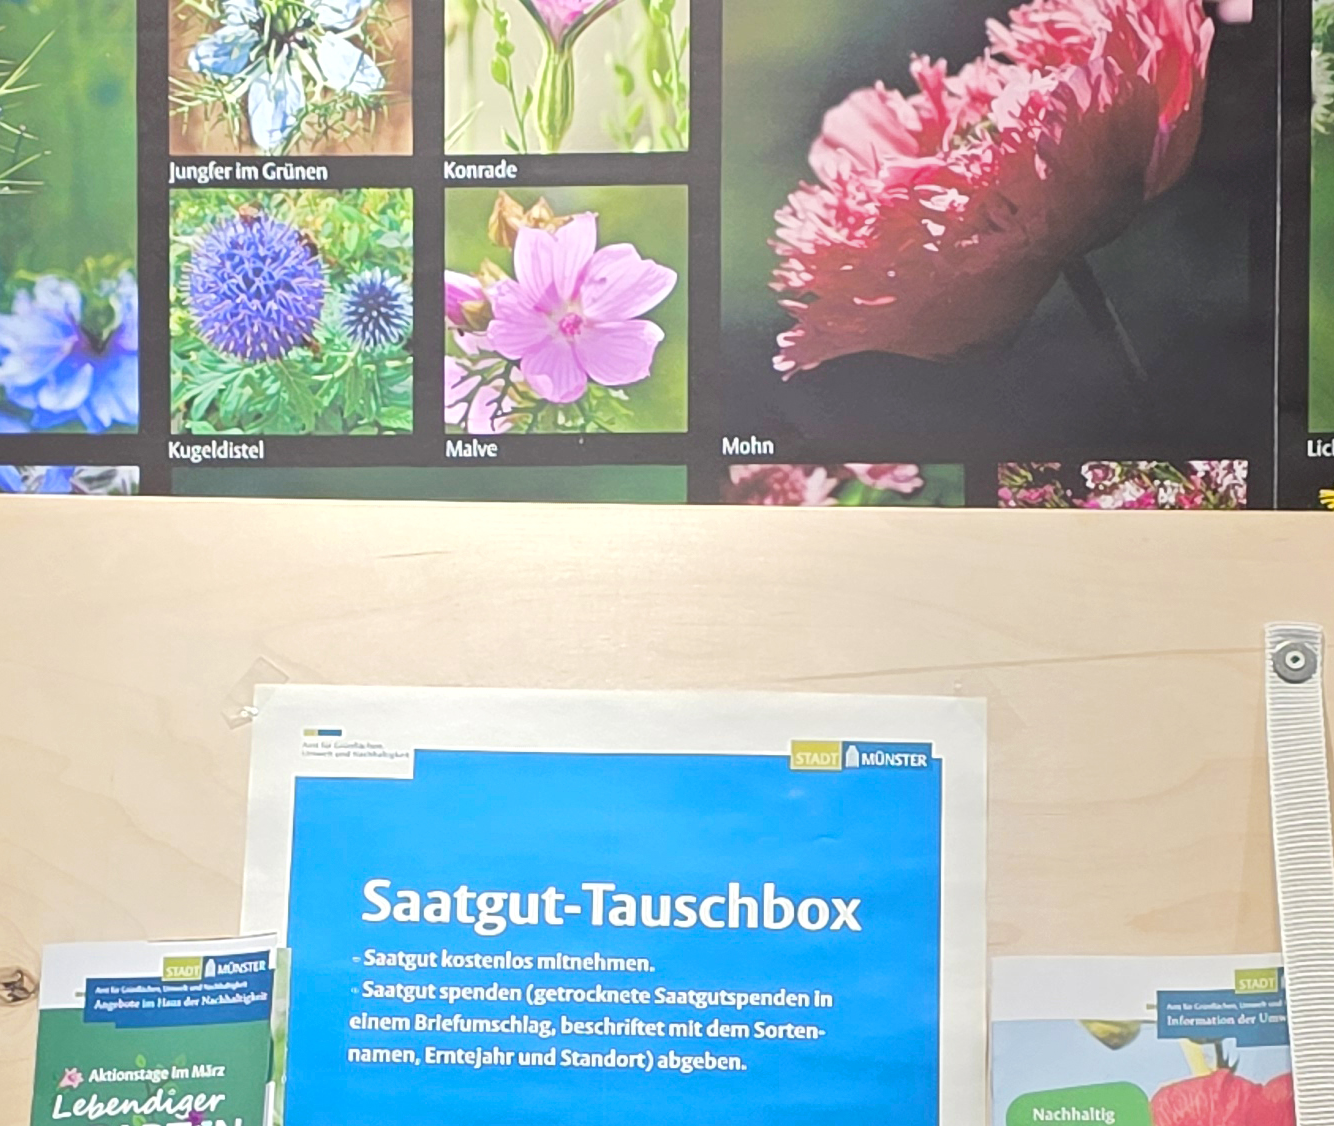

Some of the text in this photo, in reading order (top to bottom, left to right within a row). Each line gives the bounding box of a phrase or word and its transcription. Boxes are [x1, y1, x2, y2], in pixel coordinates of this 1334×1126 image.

[169, 161, 328, 183] Jungfer im Grünen
[443, 158, 518, 179] Konrade
[168, 439, 264, 464] Kugeldistel
[445, 438, 498, 458] Malve
[722, 435, 774, 455] Mohn
[795, 750, 928, 767] STADT MÜNSTER
[362, 878, 862, 936] Saatgut-Tauschbox
[165, 960, 266, 978] STADT MÜNSTER
[362, 949, 438, 971] Saatgut
[441, 949, 534, 970] kostenlos
[537, 951, 656, 973] mitnehmen.
[1238, 977, 1276, 990] STADT
[362, 980, 834, 1011] Saatgut spenden (getrocknete Saatgutspenden in
[349, 1012, 826, 1040] einem Briefumschlag, beschriftet mit dem Sorten-
[1167, 1014, 1235, 1026] Information
[1237, 1013, 1256, 1025] der
[347, 1046, 748, 1074] namen, Erntejahr und Standort) abgeben.
[88, 1064, 226, 1084] Aktionstage im März
[52, 1088, 226, 1120] Lebendiger
[1032, 1107, 1116, 1125] Nachhaltig
